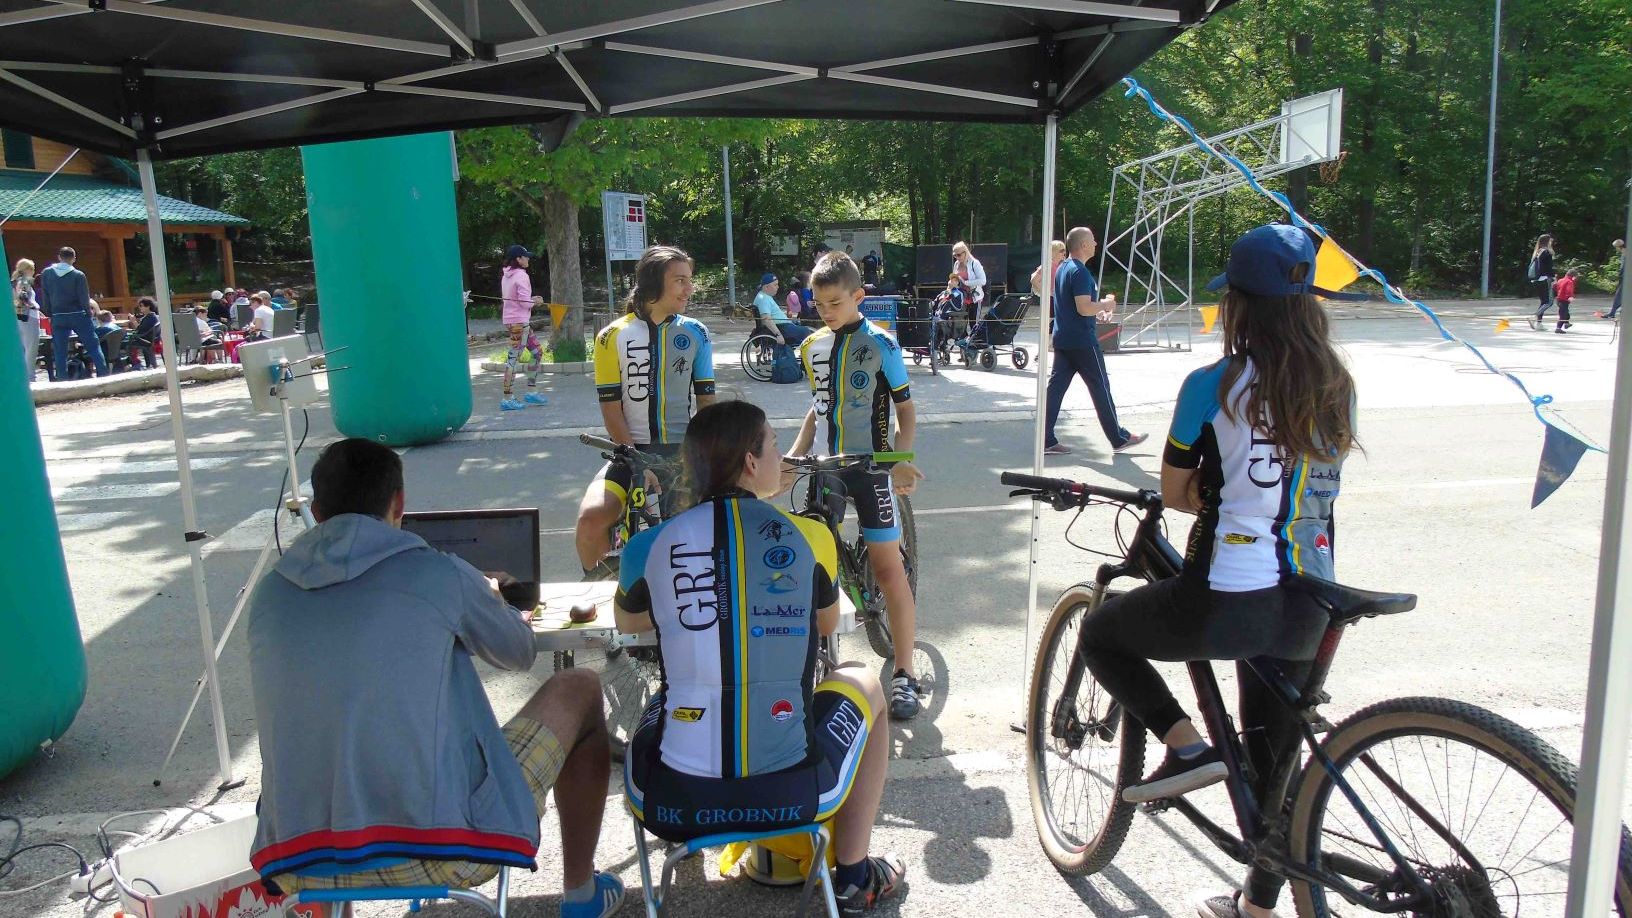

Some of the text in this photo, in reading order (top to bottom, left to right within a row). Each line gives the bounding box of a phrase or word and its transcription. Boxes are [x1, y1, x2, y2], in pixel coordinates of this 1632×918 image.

[627, 340, 650, 402] GRT
[812, 353, 831, 416] GRT
[873, 484, 892, 522] GRT
[671, 543, 718, 631] GRT
[752, 604, 806, 617] La Mer
[827, 700, 861, 746] GRT
[656, 805, 802, 825] BK GROBNIK
